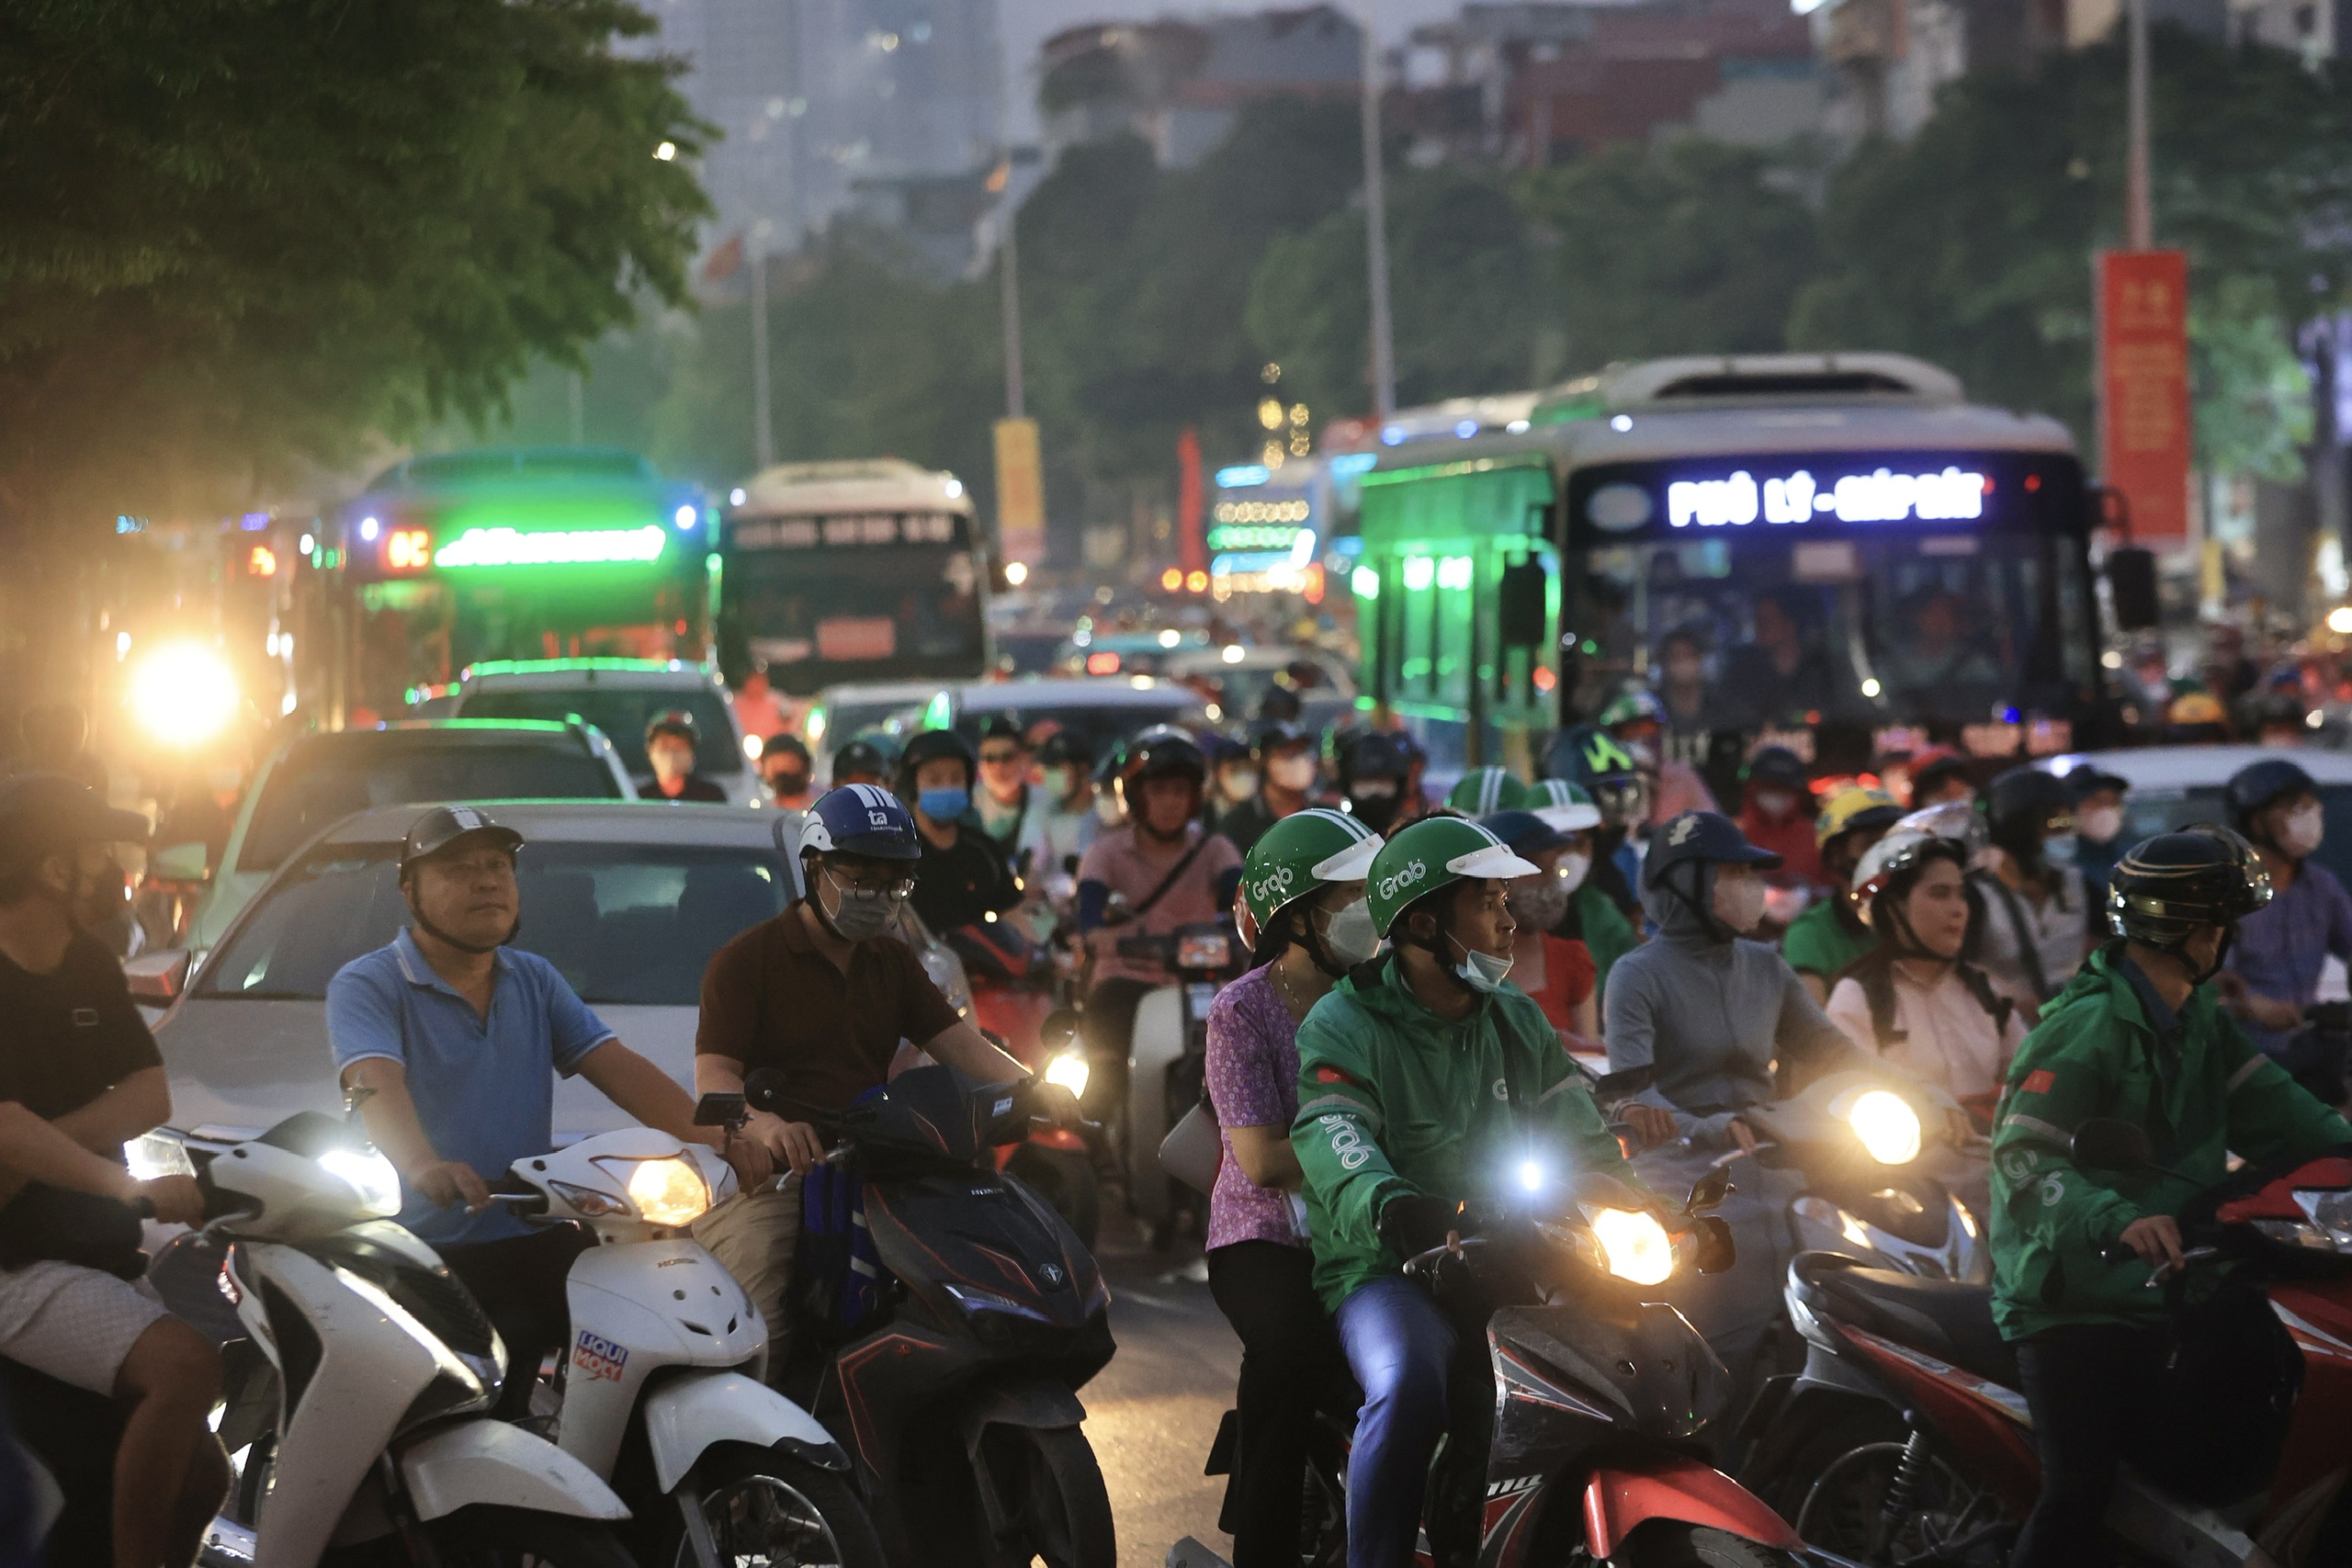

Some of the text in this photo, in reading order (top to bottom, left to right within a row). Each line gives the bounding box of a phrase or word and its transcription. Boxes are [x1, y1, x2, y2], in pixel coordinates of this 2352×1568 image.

[867, 809, 888, 826] ta
[1252, 865, 1294, 902] Grab
[1379, 861, 1427, 900] Grab
[2002, 1148, 2064, 1207] Grb
[573, 1348, 624, 1381] MOLY
[579, 1332, 628, 1365] LIQUI
